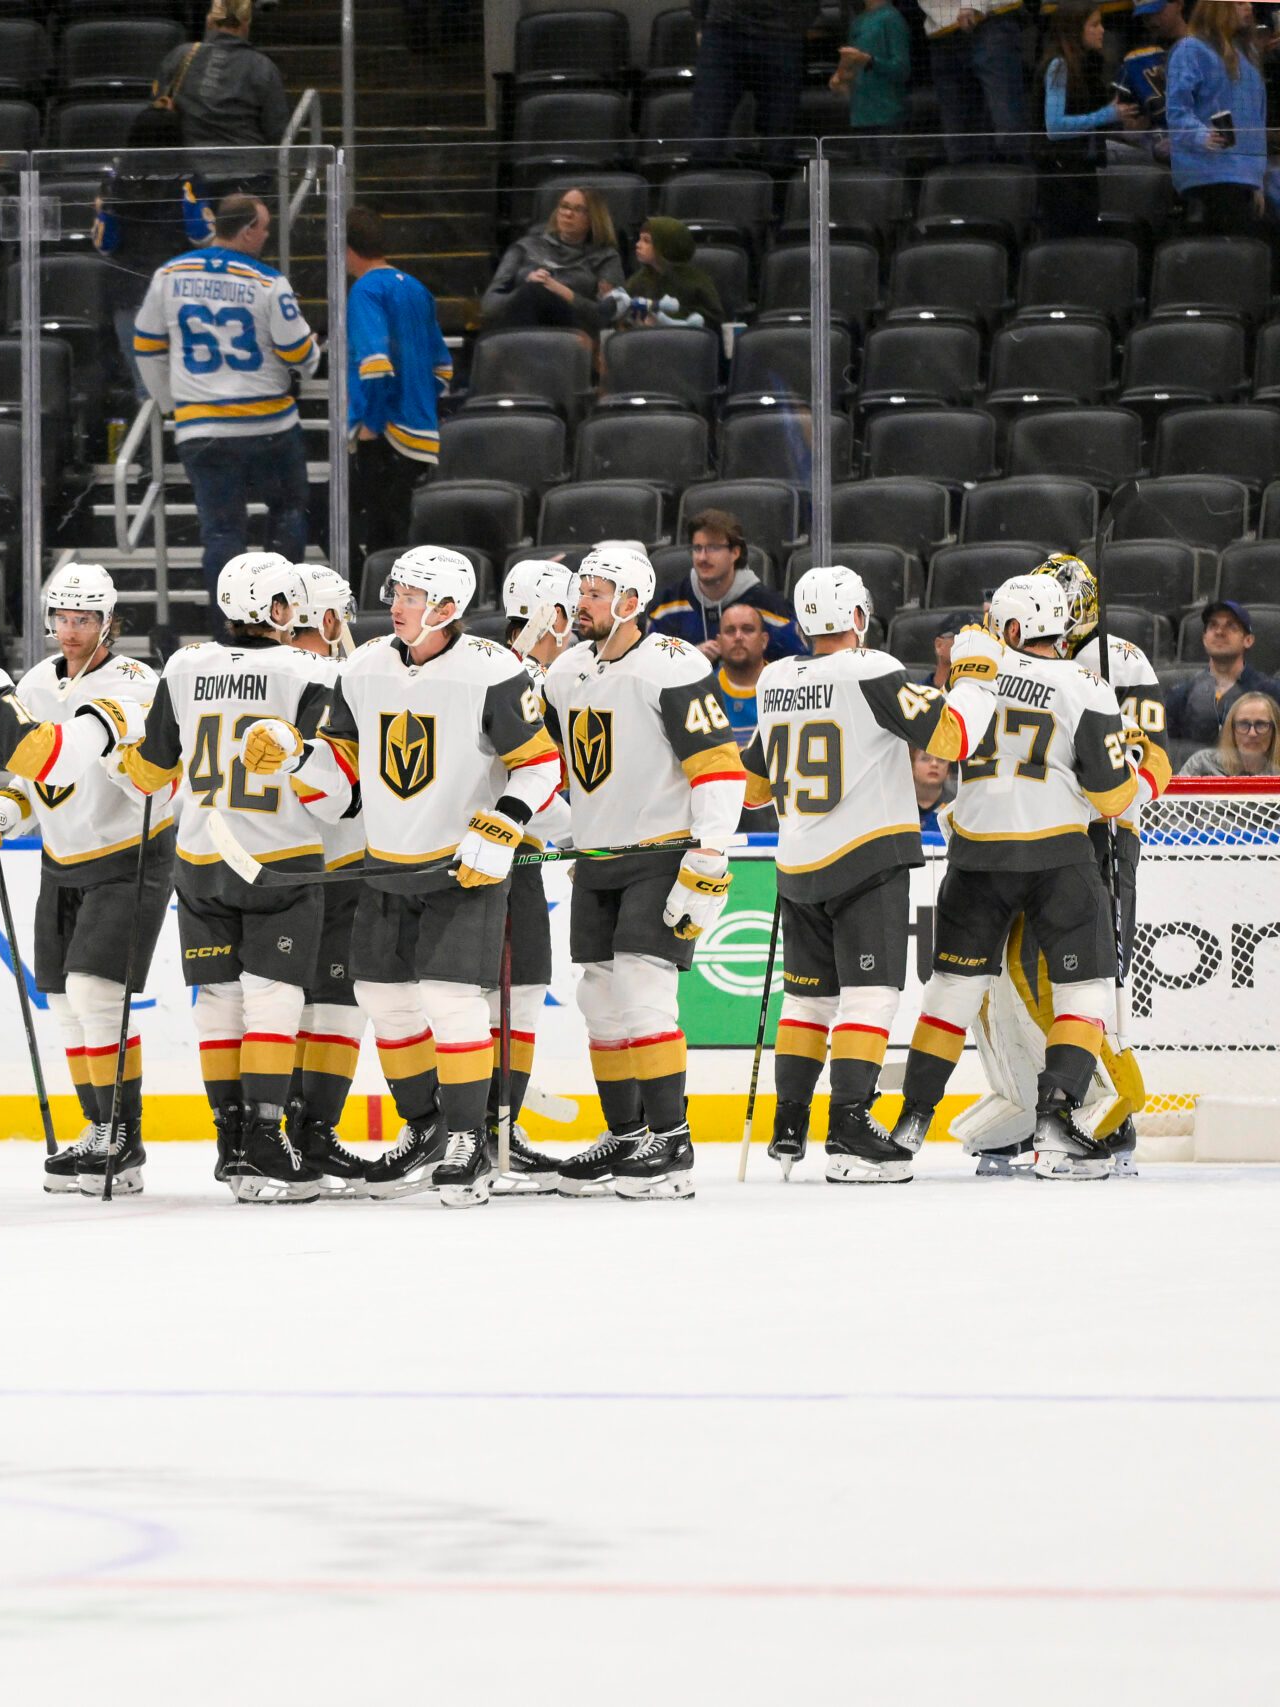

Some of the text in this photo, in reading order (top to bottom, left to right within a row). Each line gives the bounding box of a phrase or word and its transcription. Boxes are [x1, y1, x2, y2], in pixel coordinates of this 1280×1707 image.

[172, 277, 256, 305] NEIGHBOURS
[278, 292, 301, 322] 6
[177, 304, 264, 375] 63
[221, 592, 232, 605] 42
[804, 602, 817, 615] 49
[1053, 606, 1064, 618] 27
[193, 673, 268, 701] BOWMAN
[684, 692, 731, 735] 48
[766, 718, 845, 818] 49
[468, 816, 514, 843] AUER
[184, 944, 232, 960] CCM
[938, 951, 988, 968] BAUER
